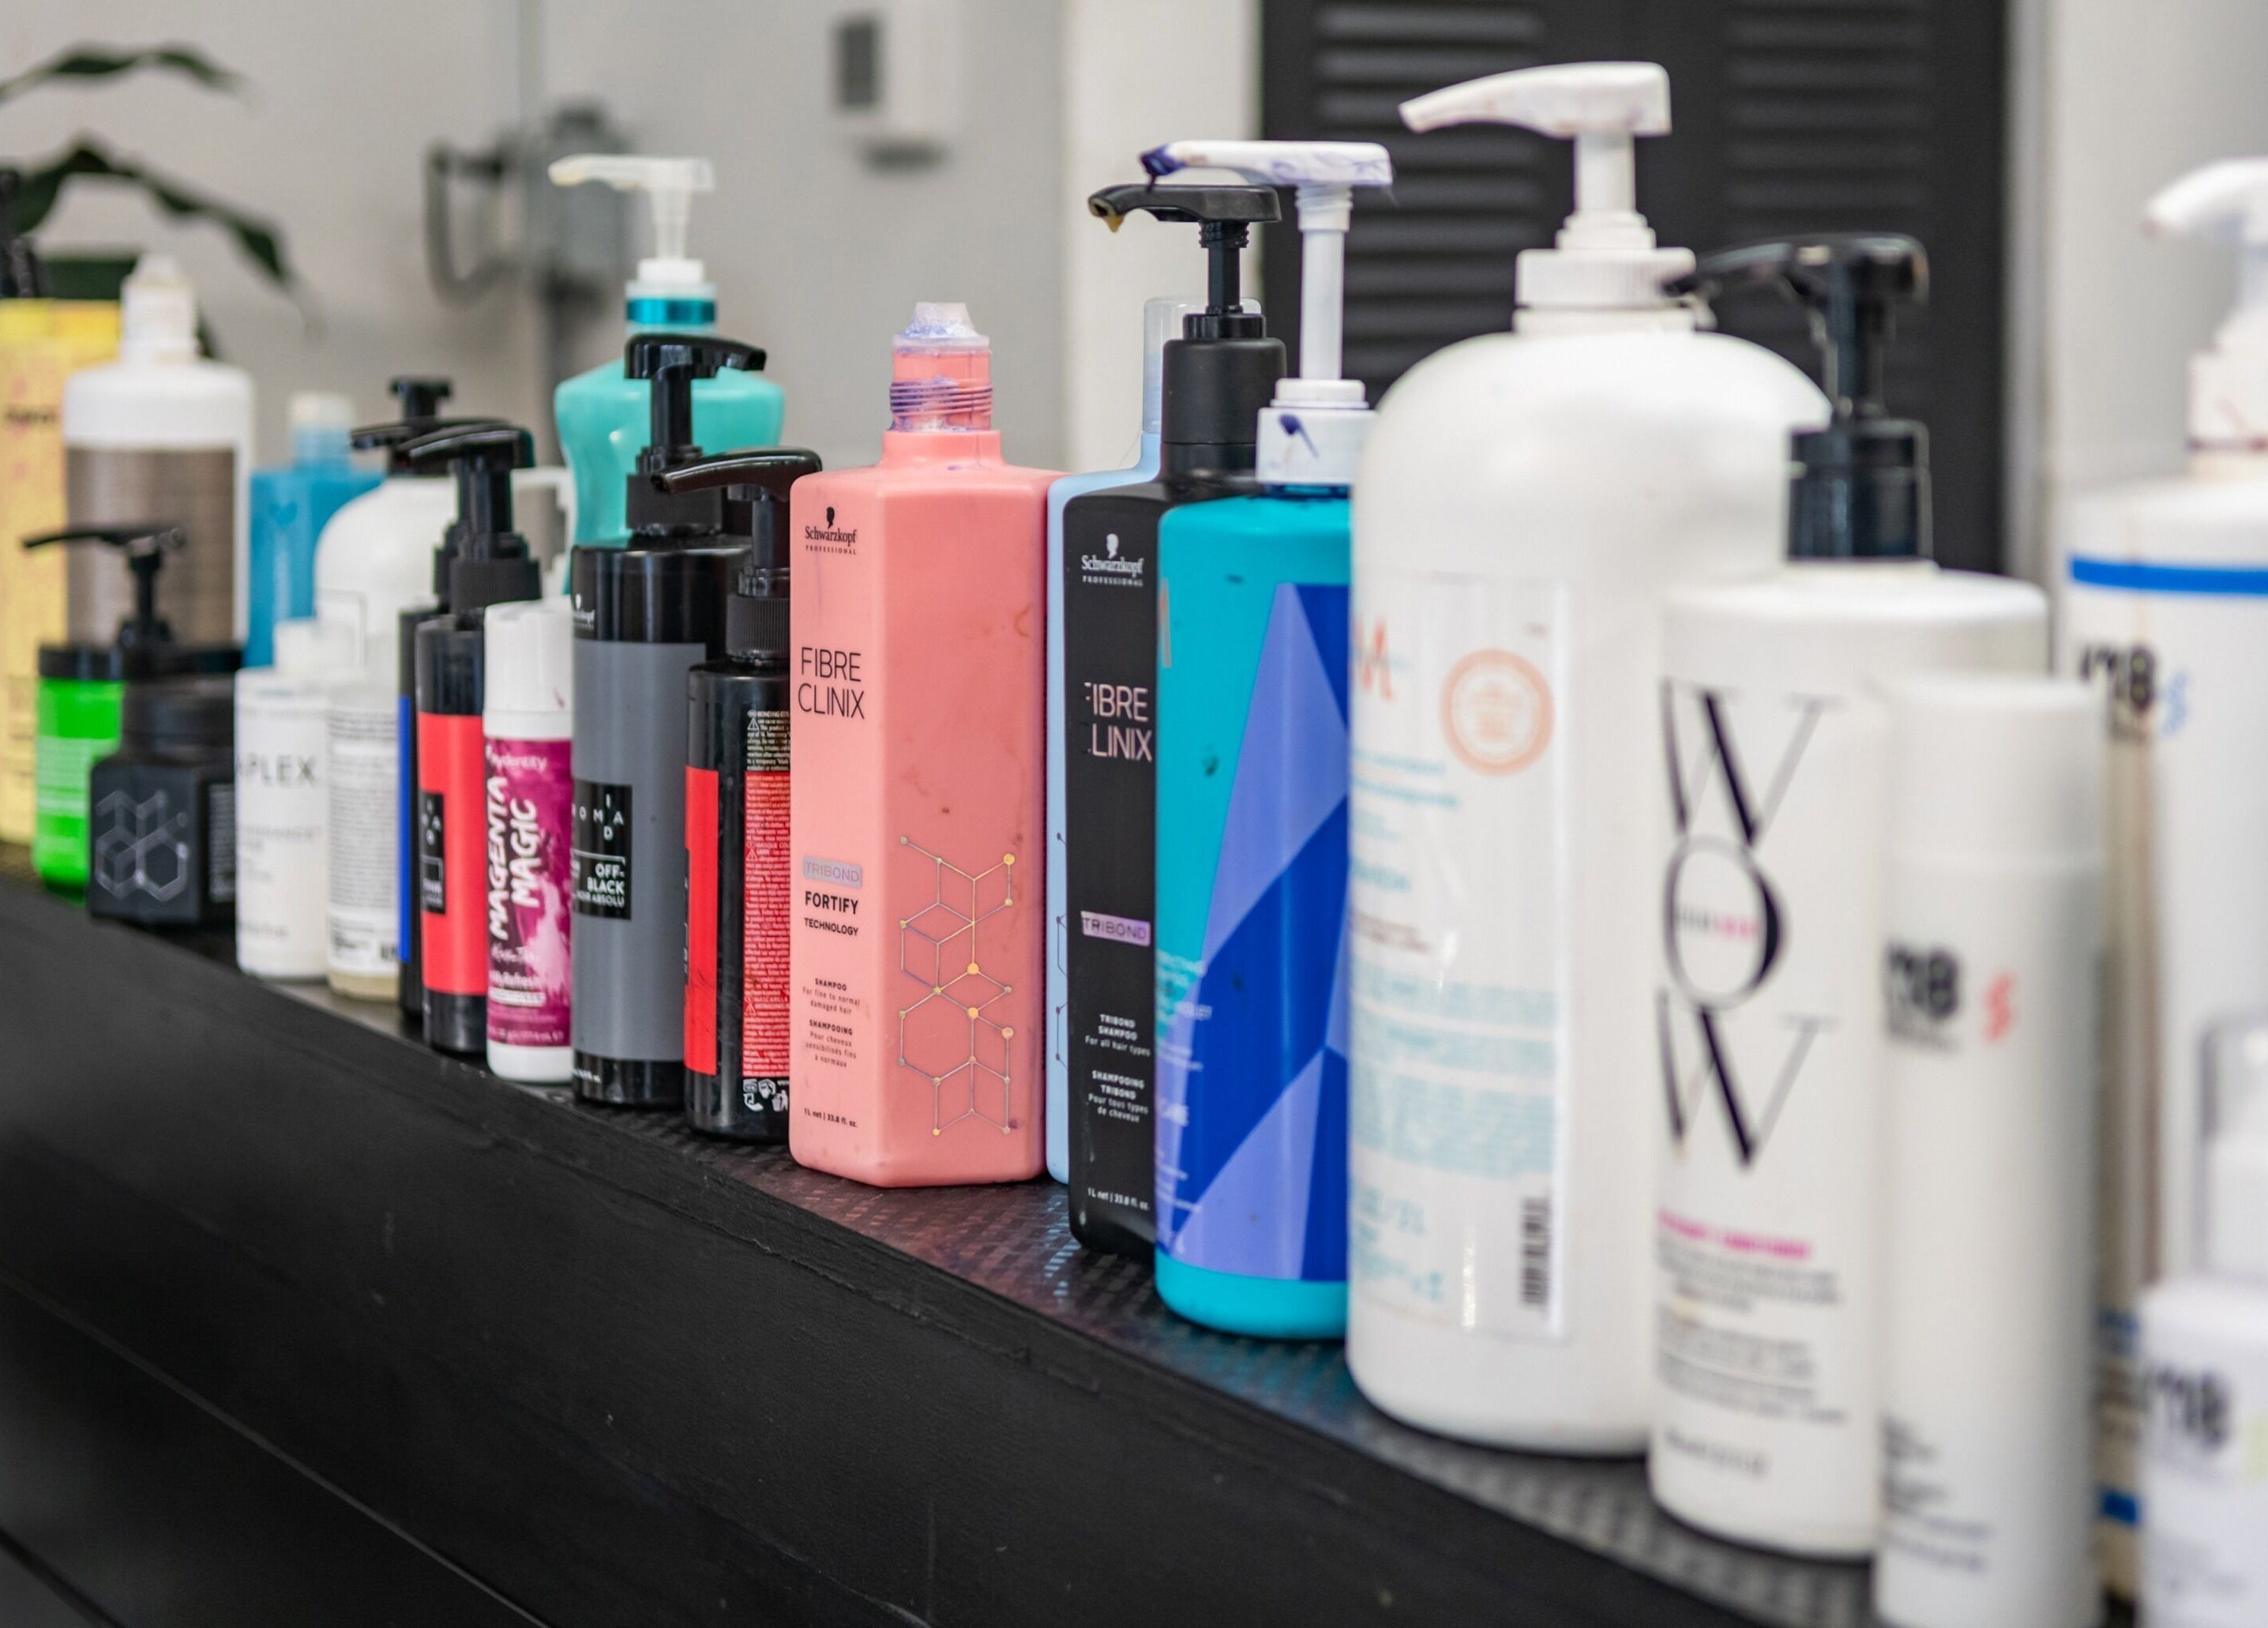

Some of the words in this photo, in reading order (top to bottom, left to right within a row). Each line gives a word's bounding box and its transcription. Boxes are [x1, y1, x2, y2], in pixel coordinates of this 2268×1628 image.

[805, 525, 858, 547] Schwarzkopf
[805, 544, 857, 555] PROFESSIONAL
[801, 646, 862, 682] FIBRE
[798, 682, 865, 720] CLINIX
[1092, 723, 1153, 763] LINIX
[486, 776, 509, 942] MAGENTA
[509, 796, 543, 909] MAGIC
[595, 863, 625, 881] OFF-
[805, 861, 860, 882] TRIBOND
[587, 876, 625, 896] BLACK
[805, 890, 859, 916] FORTIFY
[804, 917, 859, 936] TECHNOLOGY
[1081, 917, 1147, 940] TRIBOND
[815, 978, 847, 991] SHAMPOO
[809, 1019, 853, 1036] SHAMPOOING
